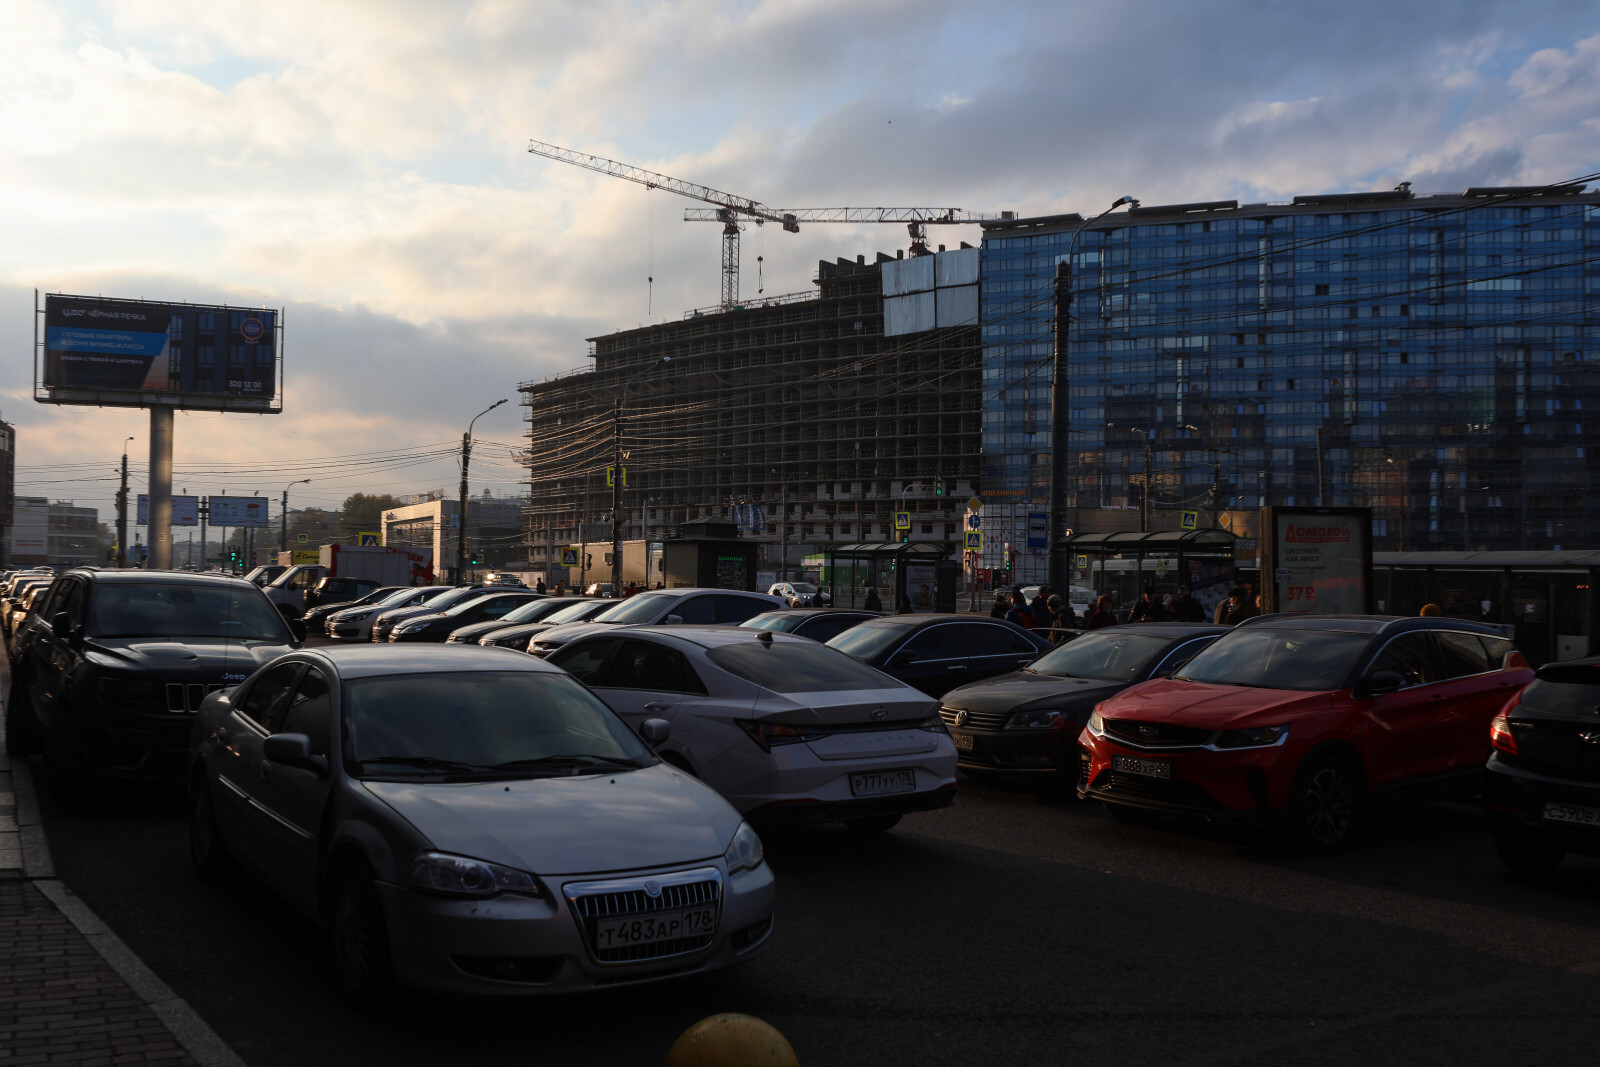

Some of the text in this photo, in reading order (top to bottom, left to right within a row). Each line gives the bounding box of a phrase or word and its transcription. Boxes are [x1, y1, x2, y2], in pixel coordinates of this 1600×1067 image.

[982, 489, 1027, 497] ЮВЕЛИРНЫЙ
[221, 672, 246, 681] Jeep
[856, 775, 895, 791] Р777УУ
[604, 918, 680, 945] Т483АР
[684, 910, 712, 928] 178
